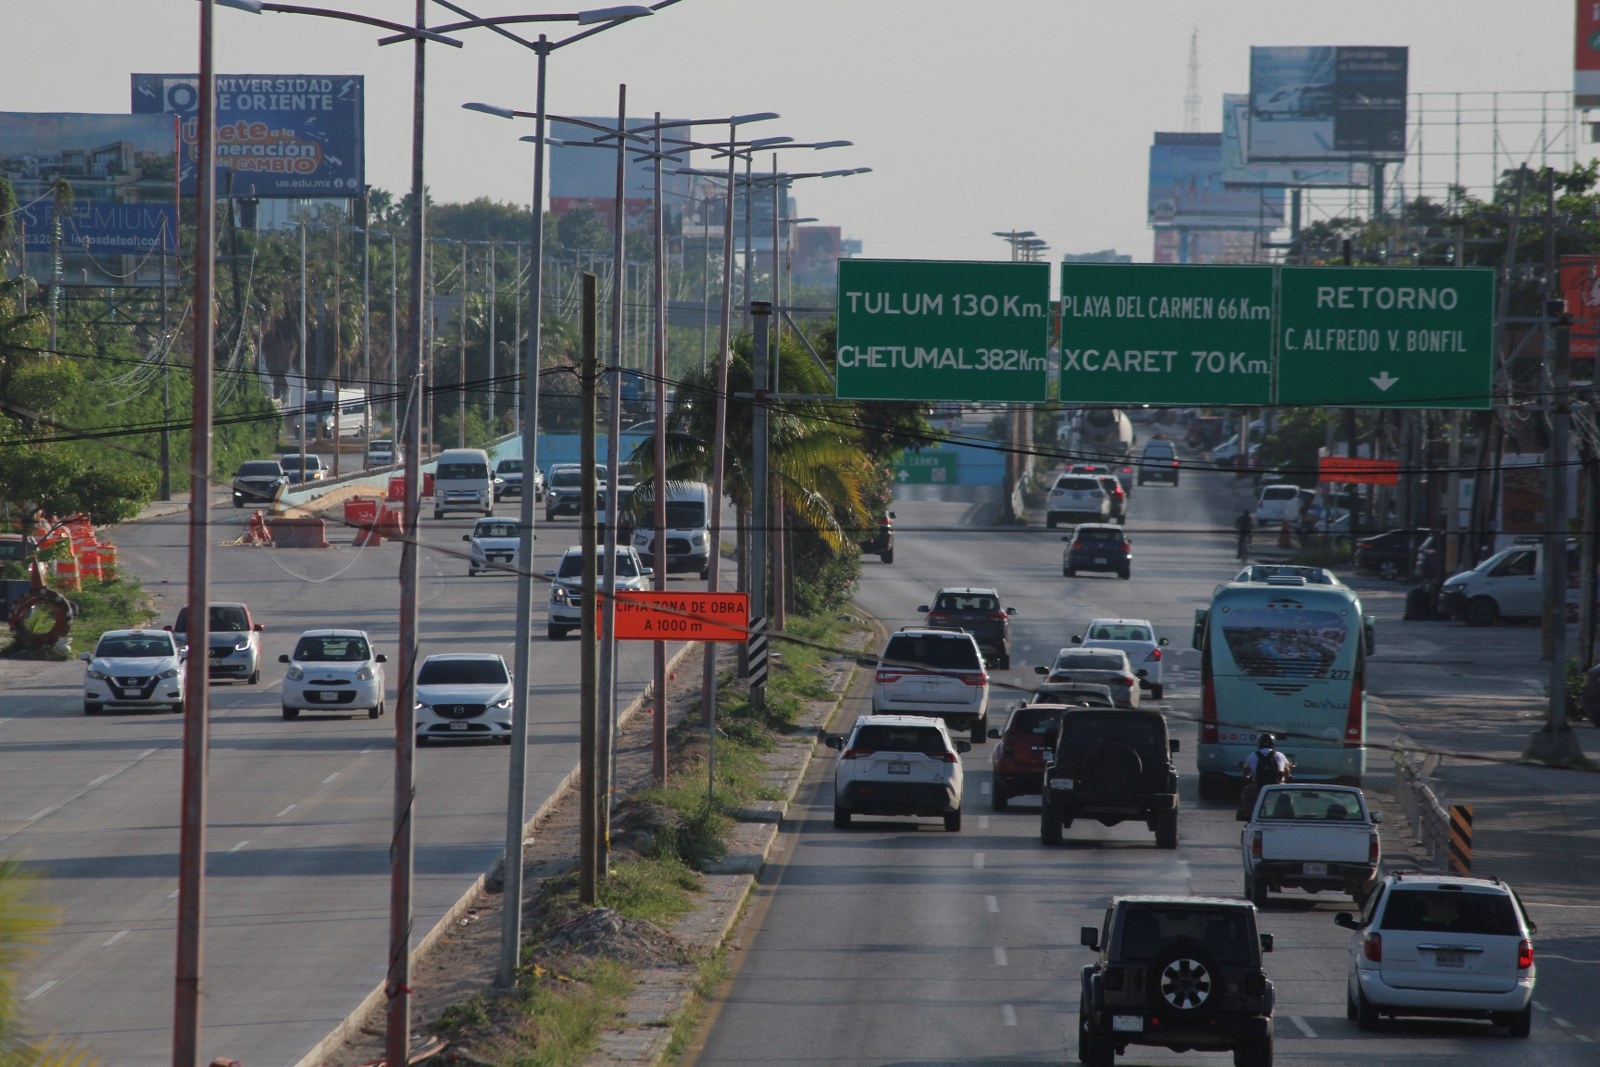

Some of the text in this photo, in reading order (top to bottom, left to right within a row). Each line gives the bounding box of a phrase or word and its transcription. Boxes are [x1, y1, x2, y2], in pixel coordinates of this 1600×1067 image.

[216, 79, 332, 92] NIVERSIDAD
[237, 95, 333, 111] ORIENTE
[182, 116, 268, 144] Úete
[194, 140, 316, 158] neración
[238, 157, 317, 174] CAMBIO
[276, 179, 331, 188] uo.edu.mx
[846, 292, 943, 316] TULUM
[1062, 295, 1112, 318] PLAYA
[1116, 296, 1145, 318] DEL
[1149, 297, 1213, 319] CARMEN
[1316, 286, 1459, 310] RETORNO
[1284, 328, 1299, 350] C.
[1303, 329, 1380, 351] ALFREDO
[1406, 330, 1467, 352] BONFIL
[838, 345, 973, 370] CHETUMAL
[1063, 349, 1178, 373] XCARET
[653, 601, 687, 613] ZONA
[691, 602, 706, 613] DE
[711, 602, 745, 613] OBRA
[644, 620, 703, 632] A 1000 m
[1330, 669, 1350, 680] 277
